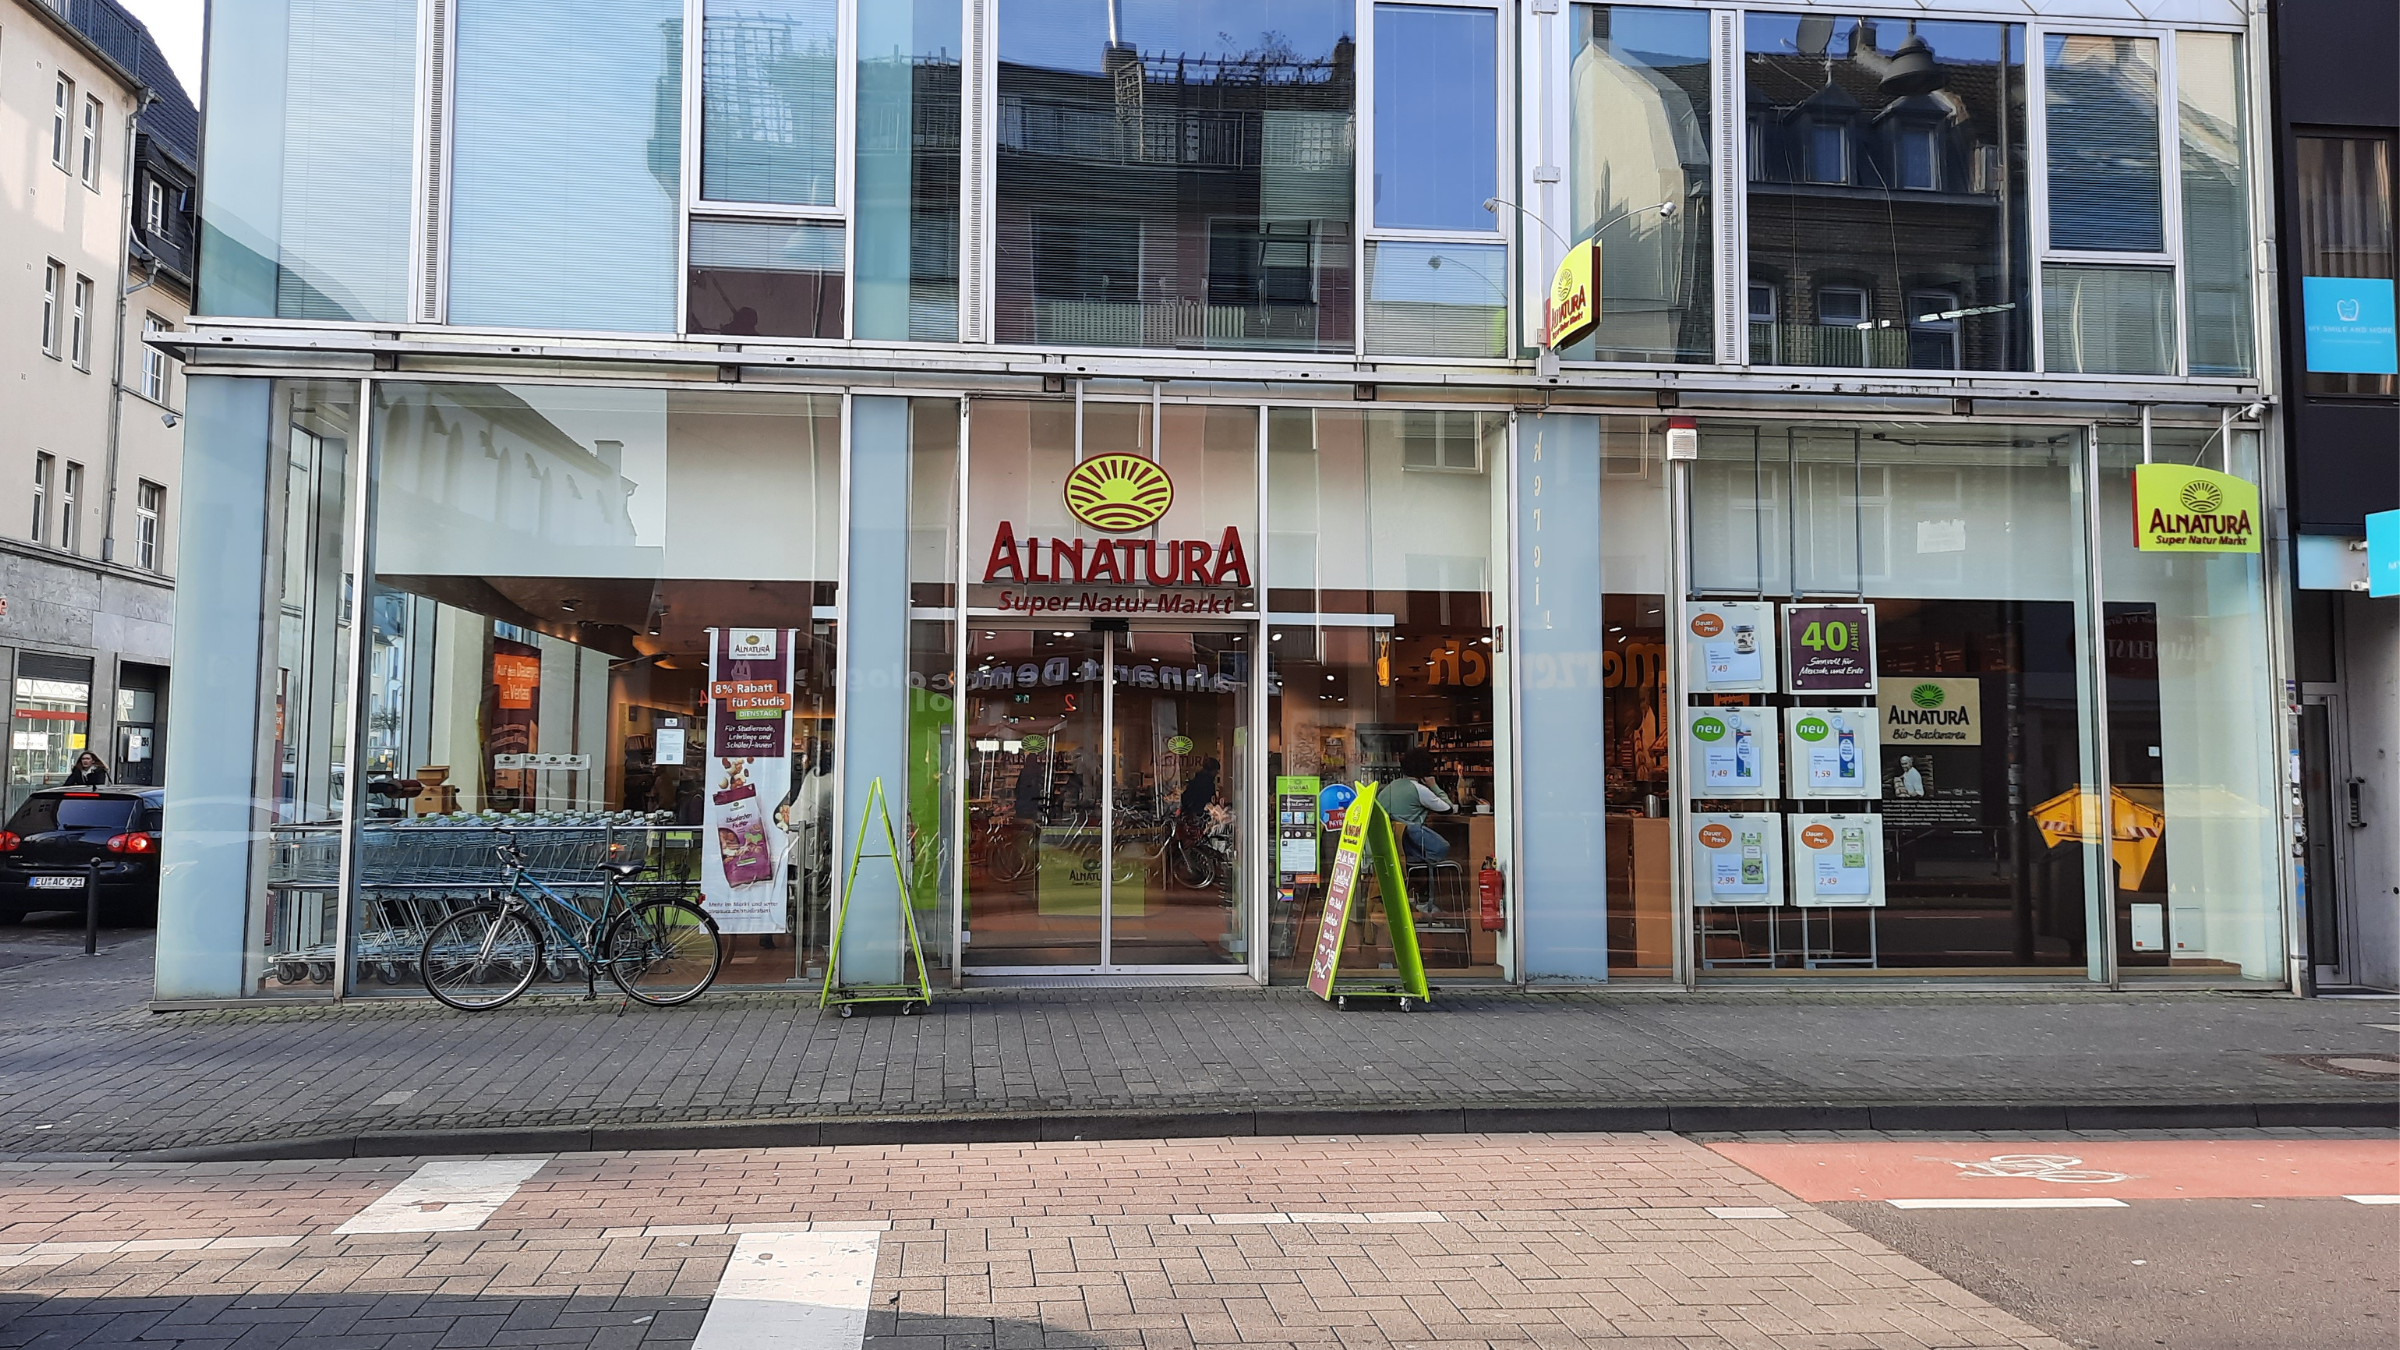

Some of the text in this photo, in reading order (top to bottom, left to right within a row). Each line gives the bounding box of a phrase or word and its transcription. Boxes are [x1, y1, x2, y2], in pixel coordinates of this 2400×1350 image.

[2149, 508, 2252, 535] ALNATURA
[2156, 535, 2247, 546] Super Natur Markt
[982, 521, 1251, 587] ALNATURA
[997, 591, 1233, 616] Super Natur Markt
[1695, 619, 1714, 627] Dauer
[1704, 625, 1719, 633] Preis
[1801, 621, 1848, 652] 40
[1850, 621, 1859, 652] JAHRE
[735, 644, 770, 653] ALNATURA
[1807, 656, 1855, 667] Sinnvoll für
[1711, 664, 1728, 673] 7,49
[1799, 666, 1865, 677] Mensch und Erde
[715, 683, 773, 694] 8% Rabatt
[732, 696, 785, 707] für Studis
[1888, 705, 1970, 726] ALNATURA
[1696, 723, 1722, 734] neu
[1800, 723, 1826, 734] neu
[1893, 728, 1966, 740] Bio-Backwaren
[1711, 769, 1728, 779] 1,49
[1814, 769, 1831, 779] 1,59
[1069, 869, 1115, 882] ALNATU
[35, 877, 83, 886] EU AC 921
[1717, 877, 1735, 886] 2,99
[1819, 877, 1838, 887] 2,49
